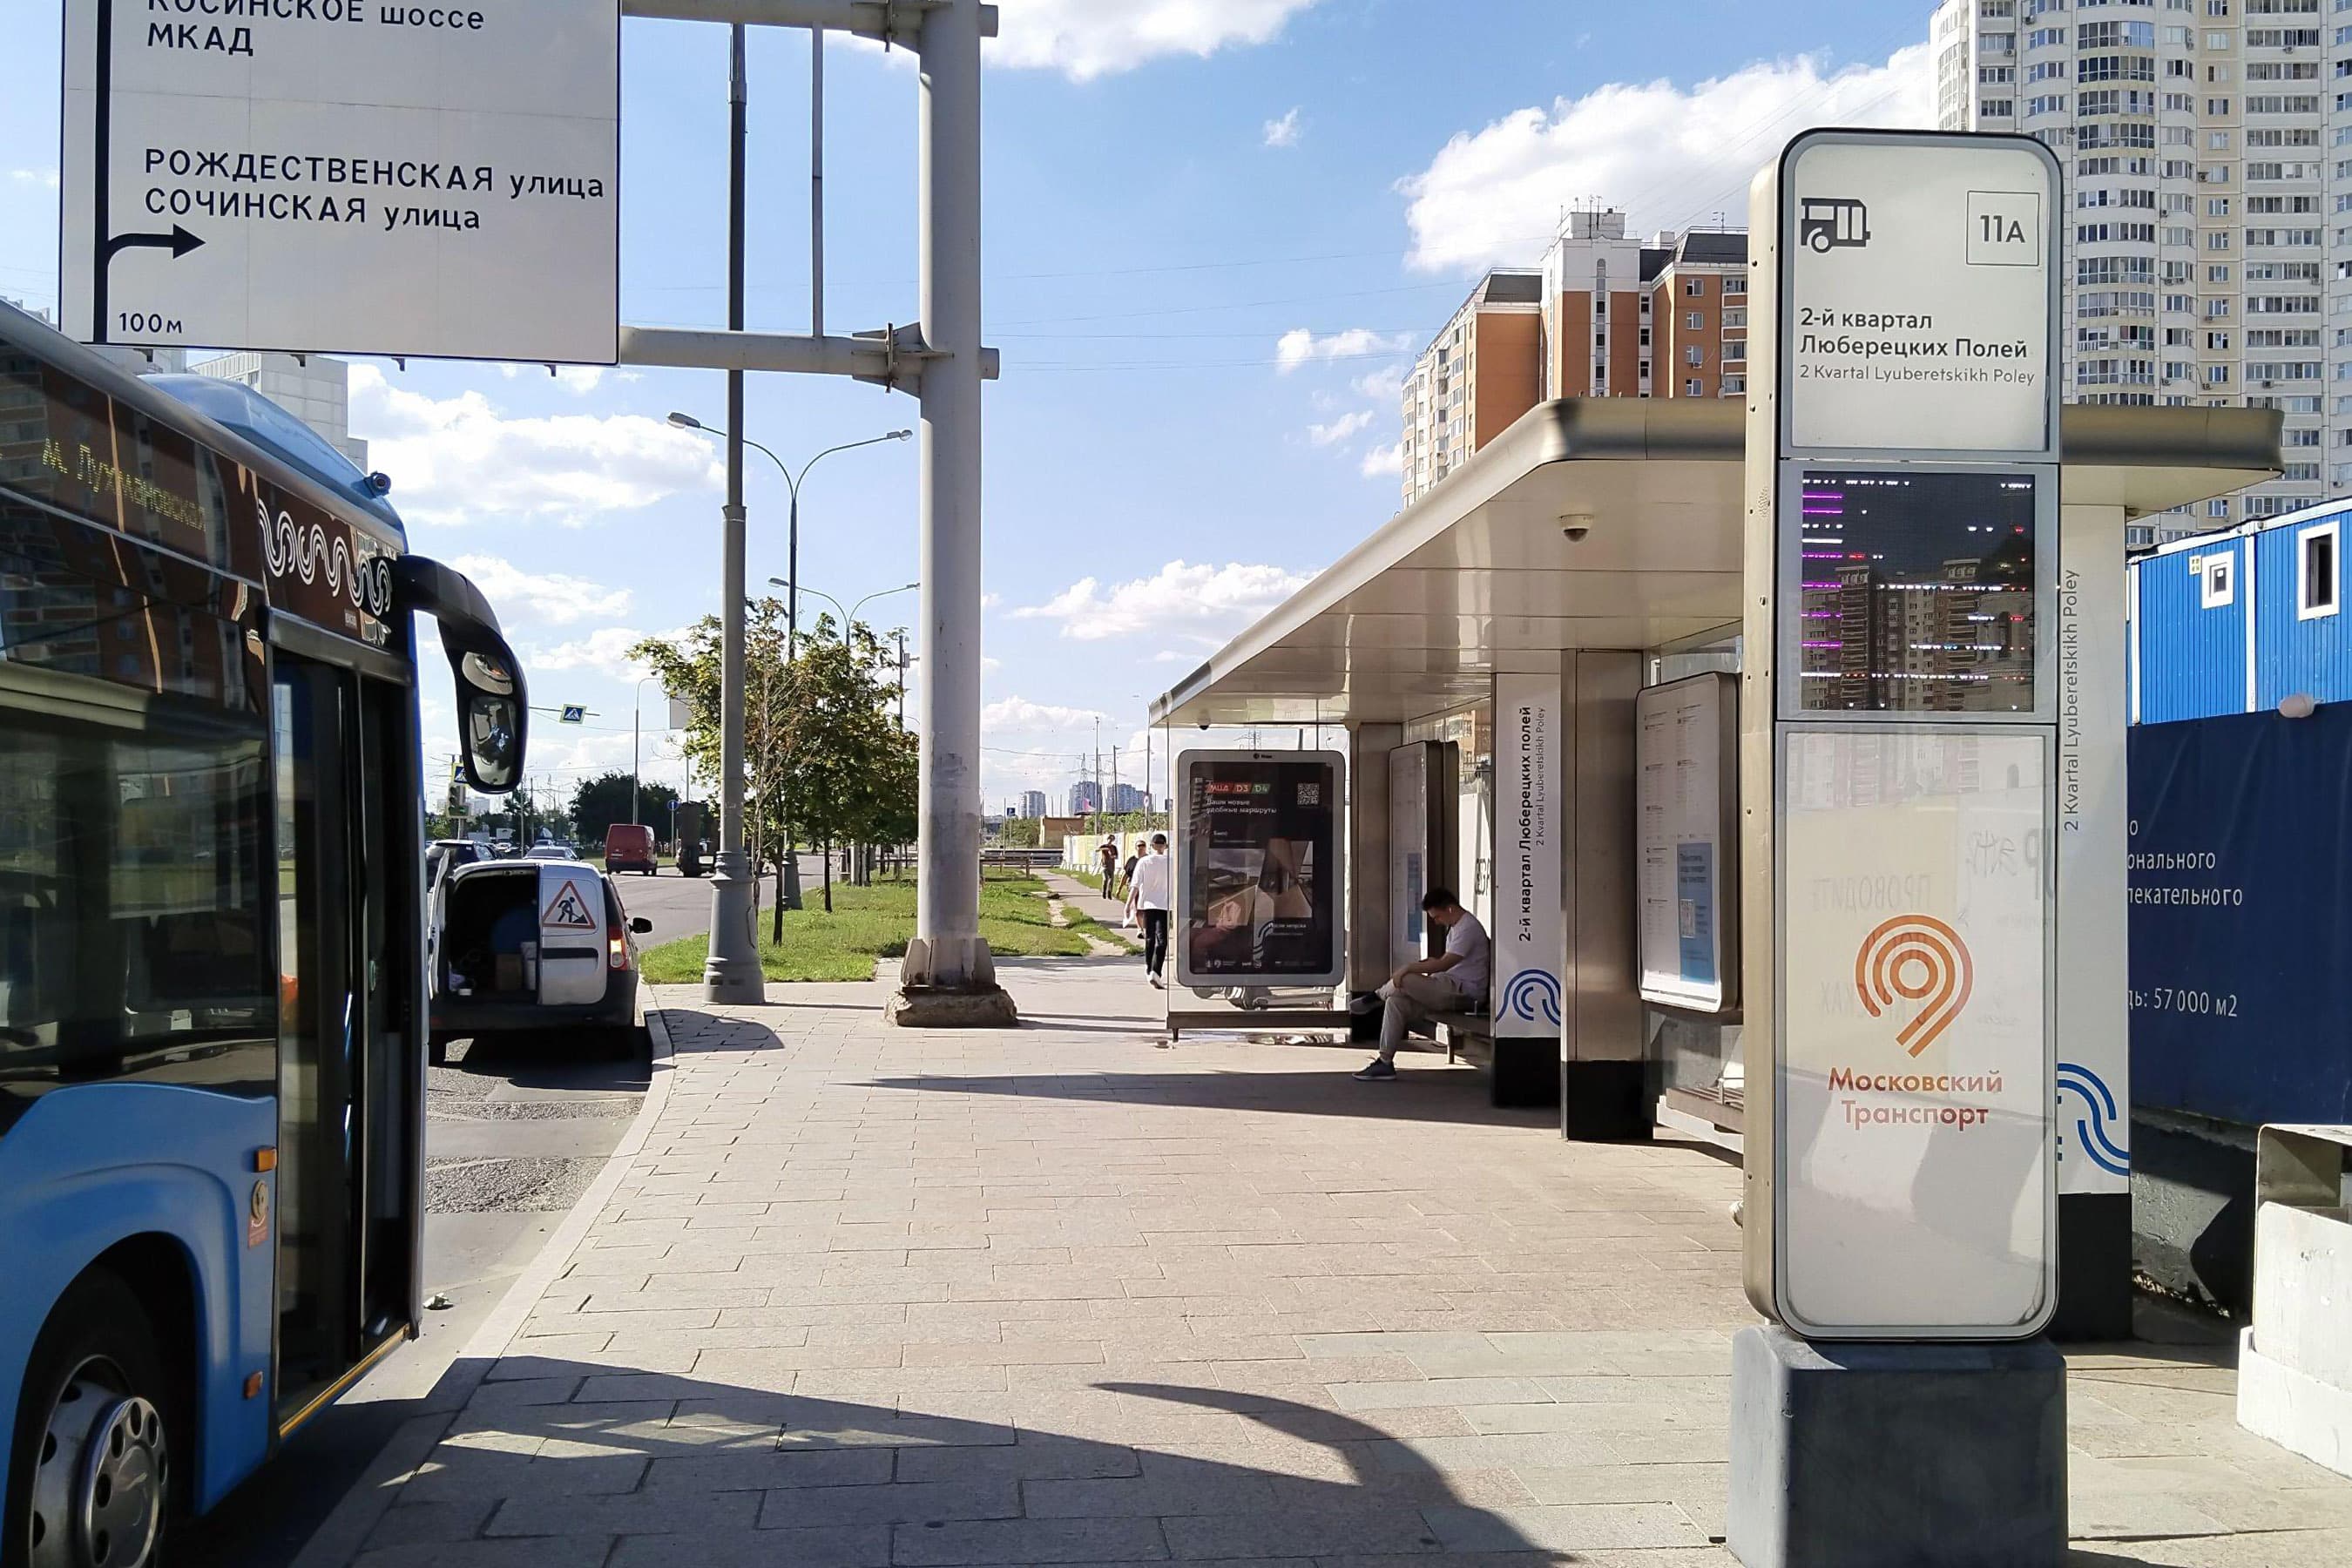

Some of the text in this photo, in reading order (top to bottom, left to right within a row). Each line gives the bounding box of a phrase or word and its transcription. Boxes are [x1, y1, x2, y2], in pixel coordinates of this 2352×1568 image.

[381, 5, 485, 30] шоссе
[147, 23, 253, 56] МКАД
[145, 149, 605, 199] РОЖДЕСТВЕНСКАЯ улица
[145, 188, 481, 231] СОЧИНСКАЯ улица
[118, 313, 183, 334] 100м
[1801, 308, 1932, 332] 2-й квартал
[1800, 335, 2027, 359] Люберецких Полей
[1801, 365, 2035, 386] 2 Kvartal Lyuberetskikh Poley
[2063, 570, 2082, 830] 2 Kvartal Lyuberetskikh Poley
[1536, 707, 1545, 733] Poley
[1519, 706, 1533, 942] 2-й квартал Люберецких полей
[1536, 803, 1544, 837] Kvartal
[2215, 994, 2237, 1017] м2
[1829, 1067, 2003, 1092] Московский
[1842, 1100, 1989, 1131] Транспорт
